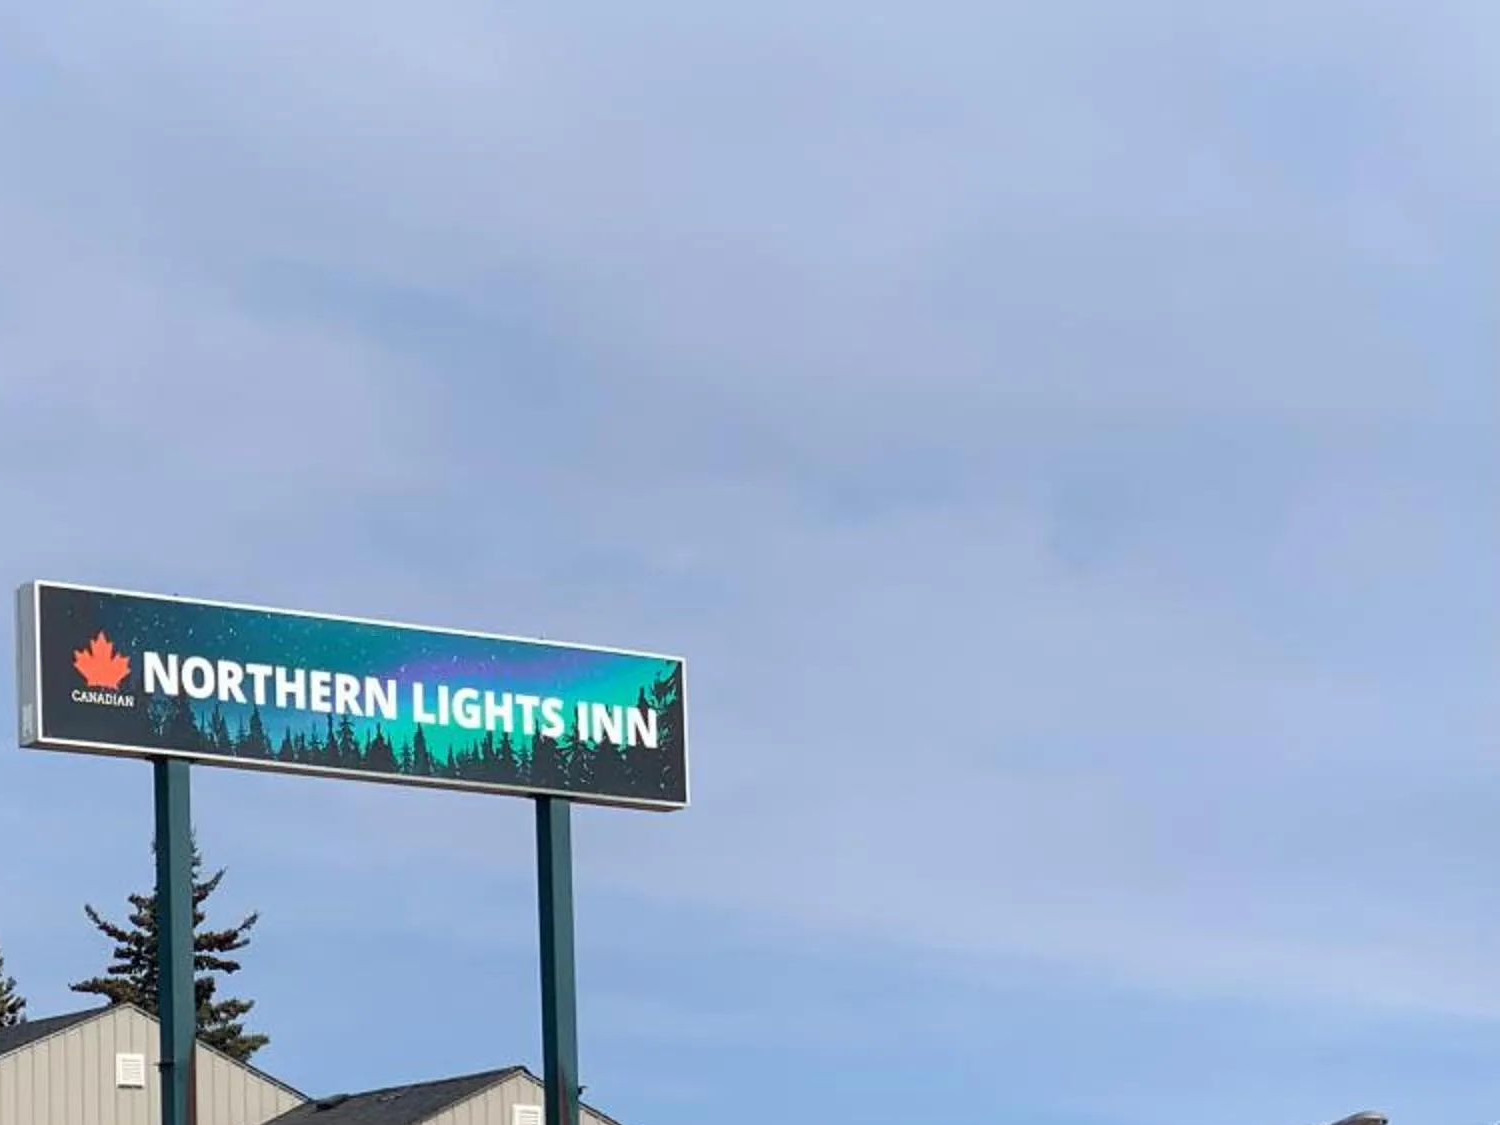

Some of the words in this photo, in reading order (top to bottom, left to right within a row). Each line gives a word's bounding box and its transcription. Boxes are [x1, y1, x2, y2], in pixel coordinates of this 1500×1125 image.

[71, 689, 135, 708] CANADIAN
[143, 651, 398, 721] NORTHERN
[412, 681, 565, 738] LIGHTS
[577, 700, 658, 749] INN
